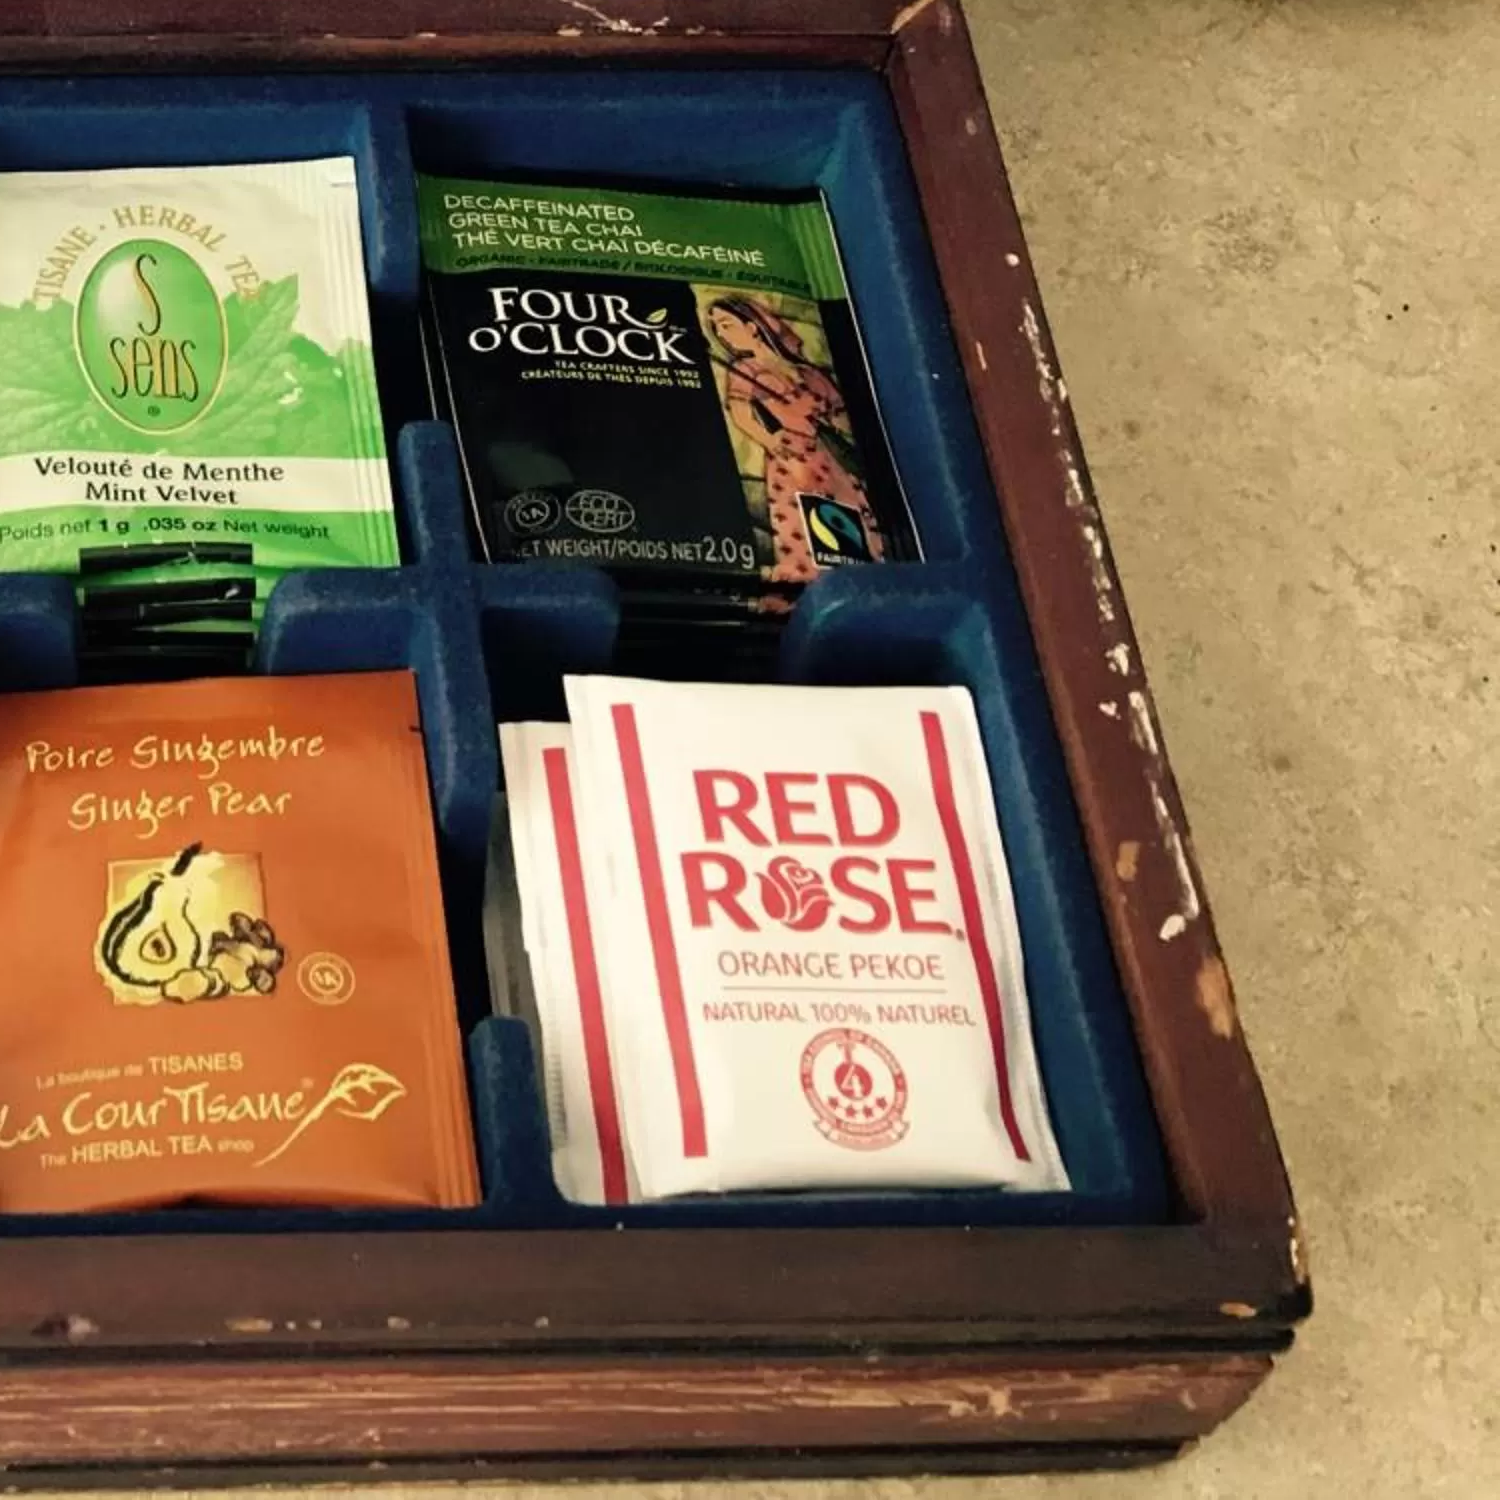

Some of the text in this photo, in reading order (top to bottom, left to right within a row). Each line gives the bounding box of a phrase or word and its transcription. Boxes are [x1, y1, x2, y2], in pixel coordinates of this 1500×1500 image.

[443, 194, 635, 221] DECAFFEINATED
[449, 211, 642, 238] GREEN TEA CHAI
[33, 225, 97, 303] TISANE
[112, 205, 227, 252] HERBAL
[452, 230, 499, 248] THÉ
[503, 233, 565, 251] VERT
[635, 238, 767, 267] DÉCAFÉINÉ
[488, 286, 668, 330] FOUR
[468, 322, 696, 365] O'CLOCK
[108, 337, 199, 402] sens
[554, 360, 576, 369] TEA
[34, 457, 284, 481] Velouté de Menthe
[85, 481, 240, 504] Mint Velvet
[99, 518, 108, 532] 1
[116, 519, 129, 535] g
[192, 519, 217, 532] oz
[223, 519, 258, 533] Net
[264, 522, 330, 540] weight
[546, 539, 668, 562] WEIGHT/POIDS
[671, 542, 703, 562] NET
[26, 725, 325, 779] Poire Gingembre
[67, 781, 292, 839] Ginger Pear
[692, 769, 901, 848] RED
[717, 950, 946, 981] ORANGE PEKOE
[703, 1001, 977, 1027] NATURAL 100% NATUREL
[148, 1052, 244, 1075] TISANES
[72, 1139, 162, 1165] HERBAL
[168, 1134, 212, 1155] TEA
